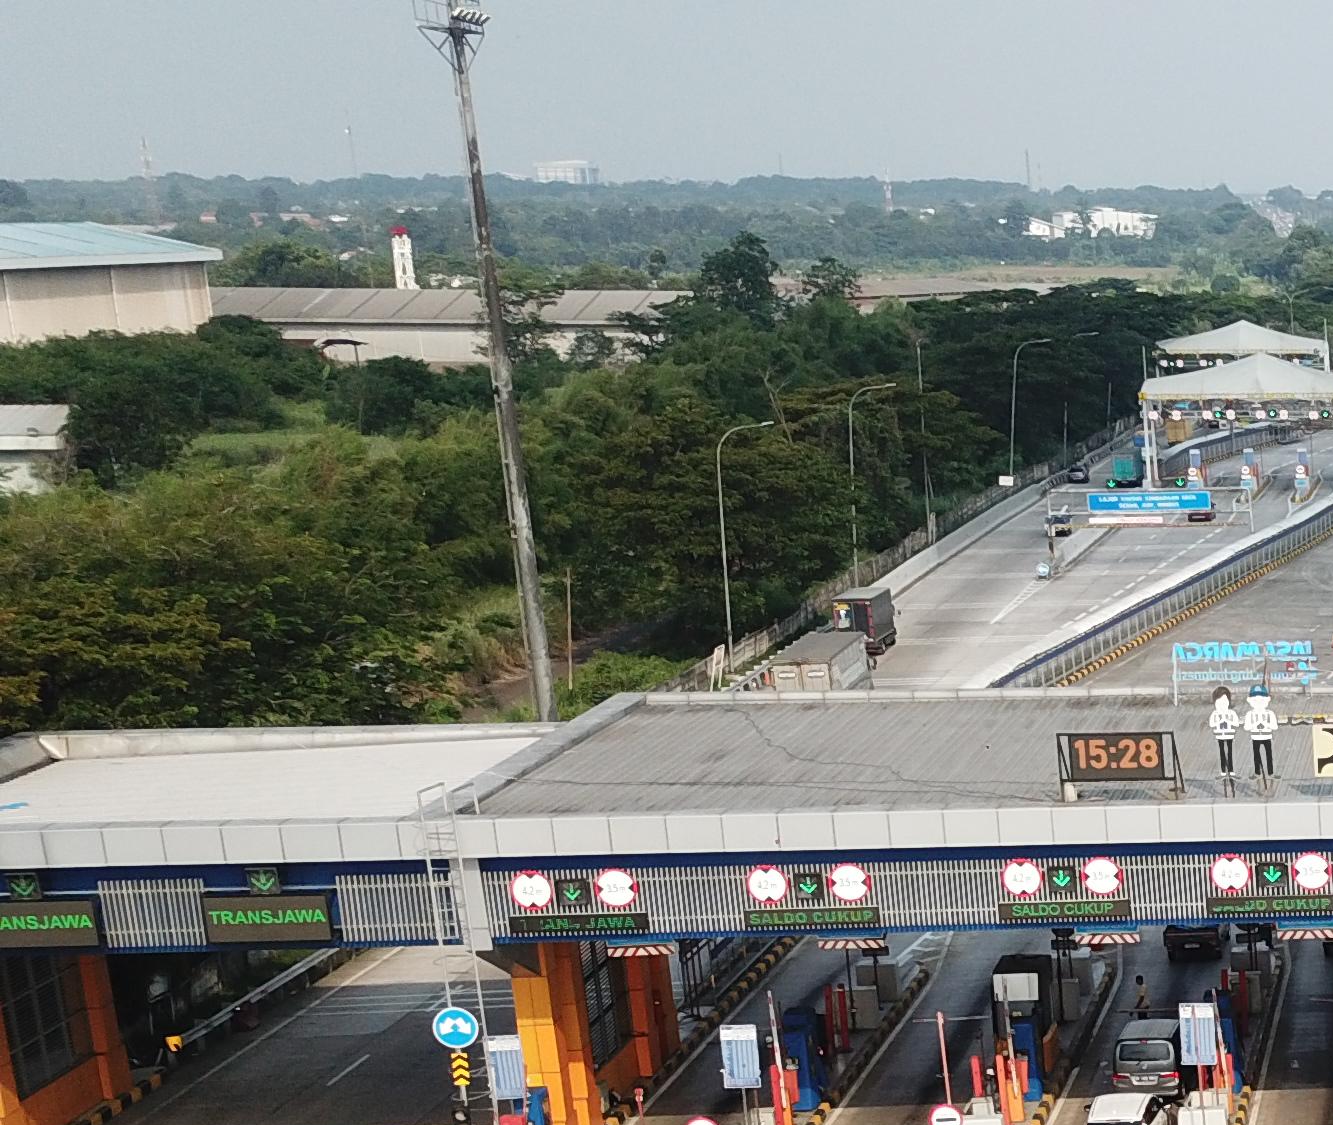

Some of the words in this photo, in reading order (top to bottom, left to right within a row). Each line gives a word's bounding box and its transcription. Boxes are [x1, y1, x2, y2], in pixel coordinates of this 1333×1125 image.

[1073, 738, 1160, 770] 15:28
[209, 908, 326, 925] TRANSJAWA
[1012, 904, 1060, 916] SALDO
[1064, 902, 1114, 914] CUKUP
[750, 912, 807, 925] SALDO
[813, 910, 874, 923] CUKUP
